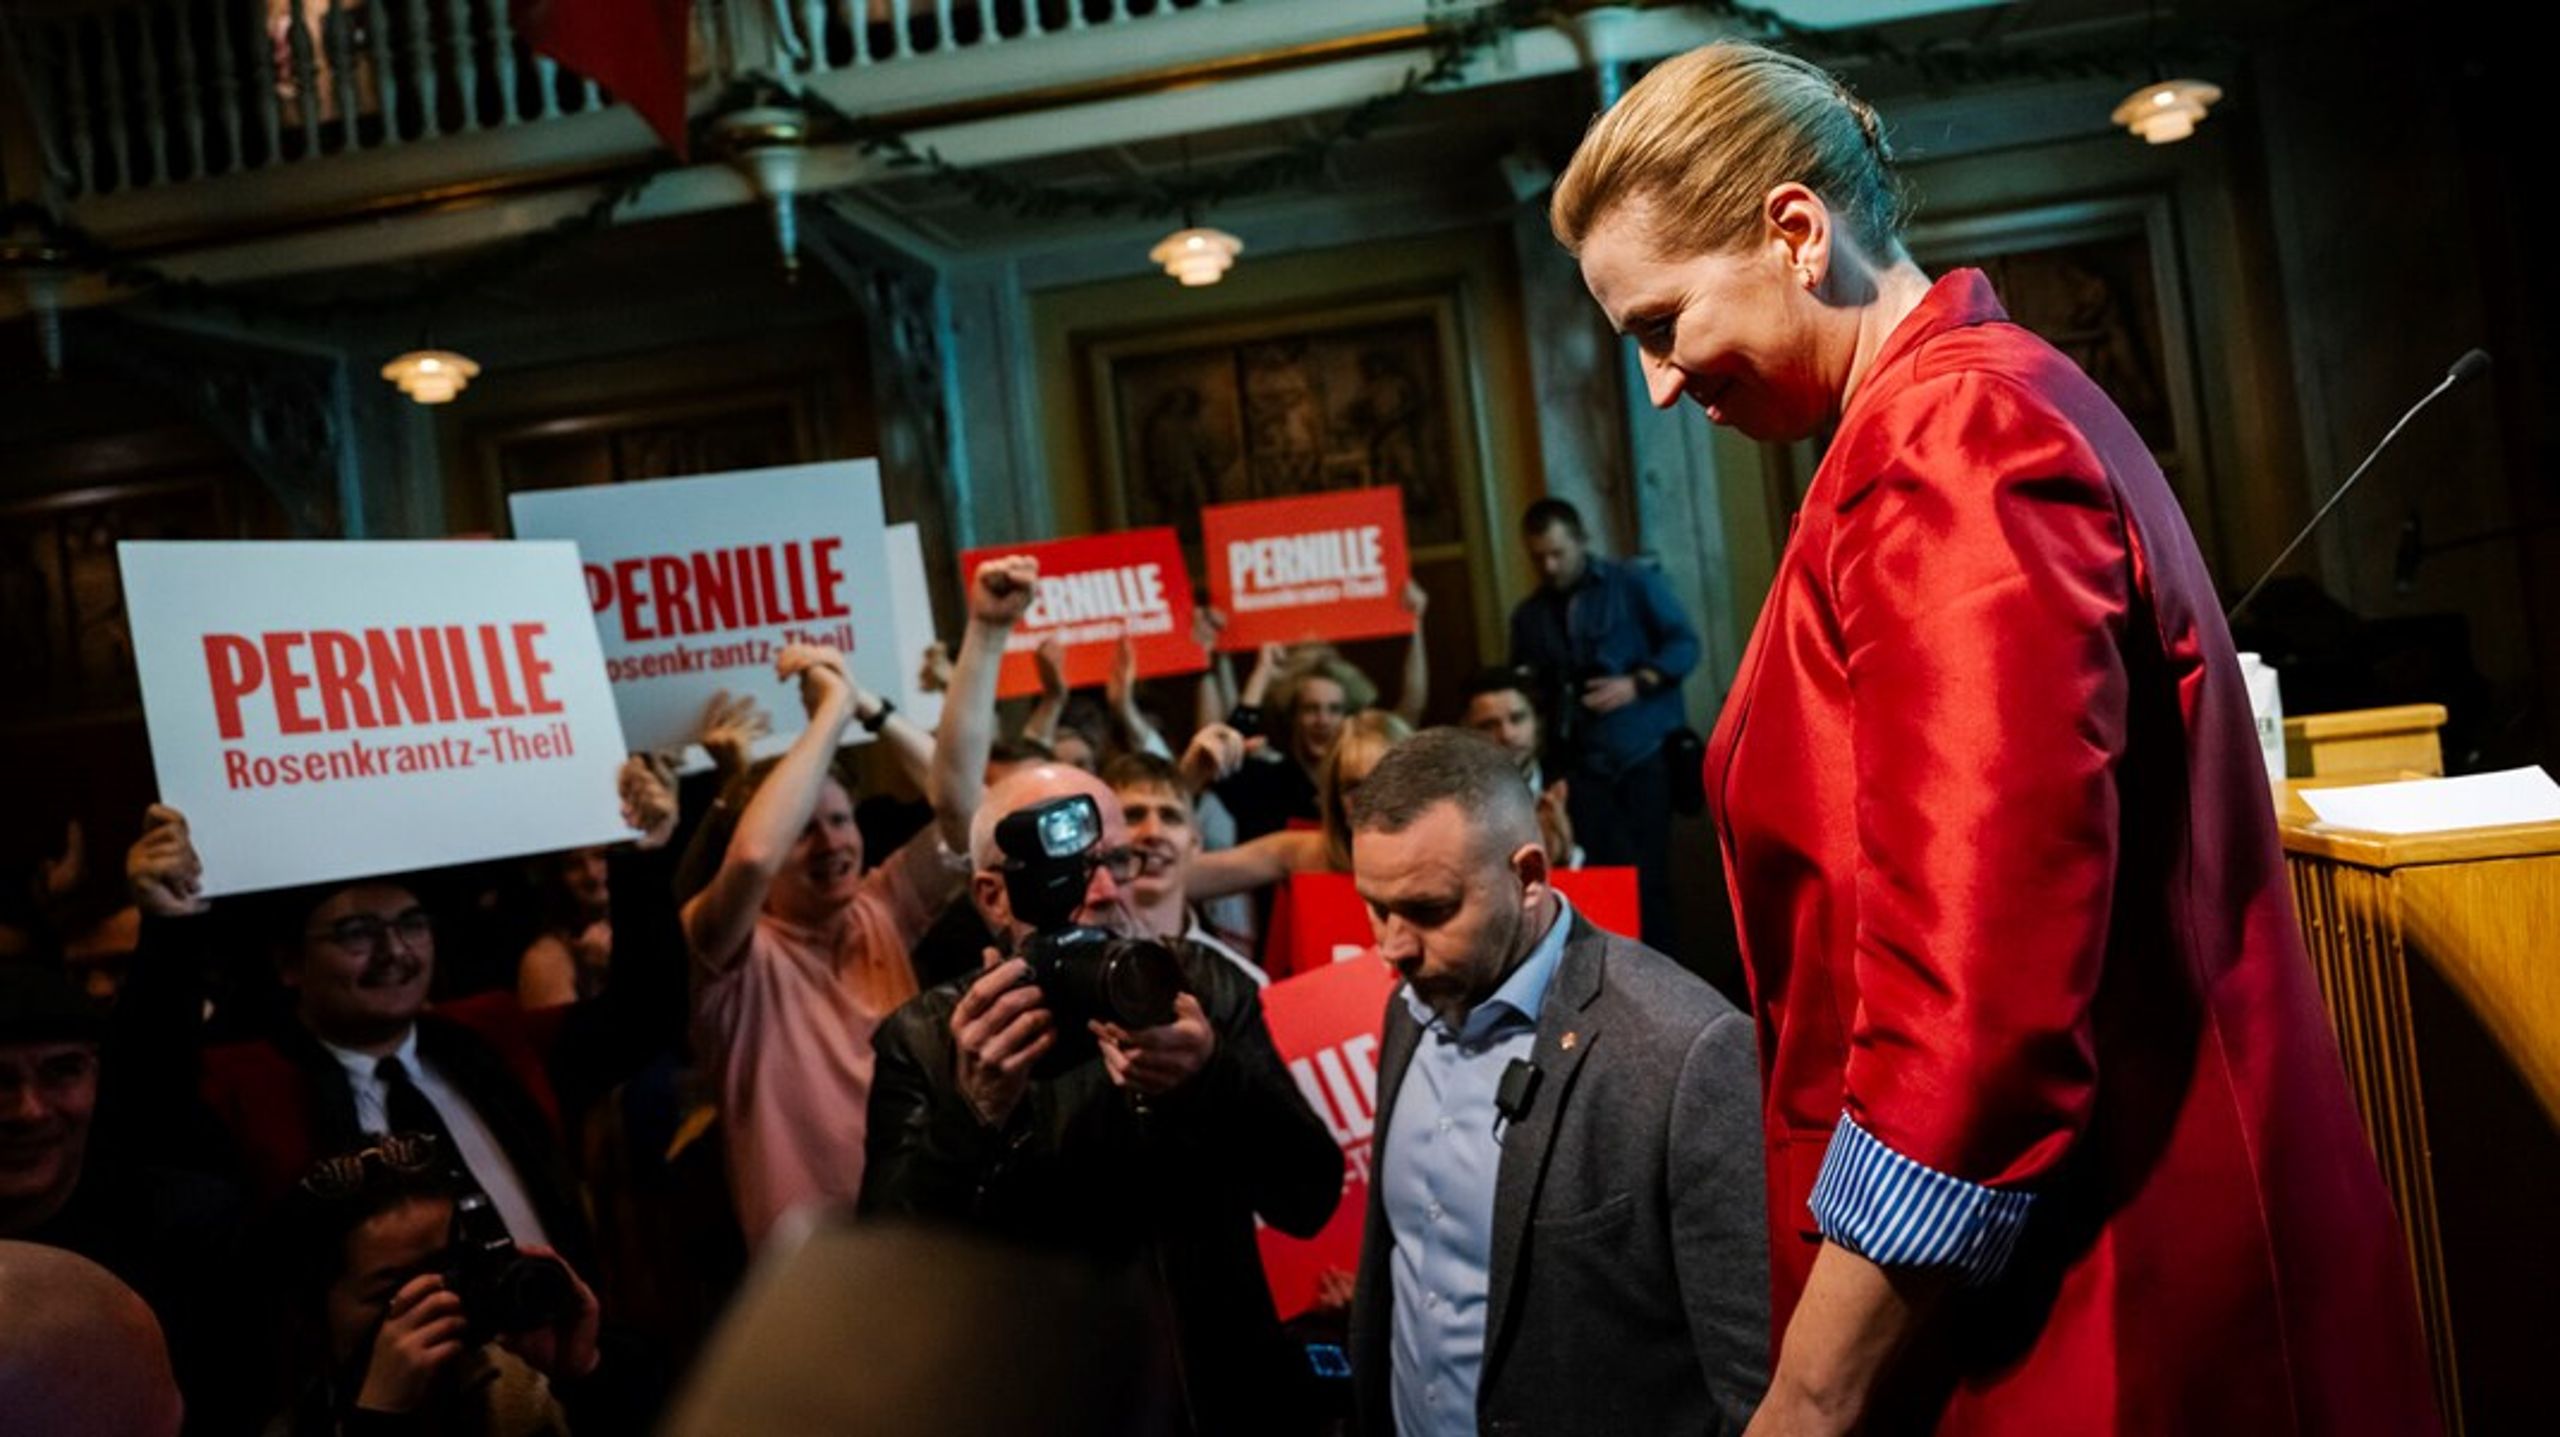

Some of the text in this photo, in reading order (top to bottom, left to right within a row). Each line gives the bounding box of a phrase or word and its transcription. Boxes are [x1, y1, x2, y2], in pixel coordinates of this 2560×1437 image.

[1228, 525, 1386, 594] PERNILLE
[1023, 563, 1170, 629] ERNILLE
[202, 622, 564, 740] PERNILLE
[606, 624, 855, 683] osenkrantz-Theil
[223, 722, 575, 791] Rosenkrantz-Theil
